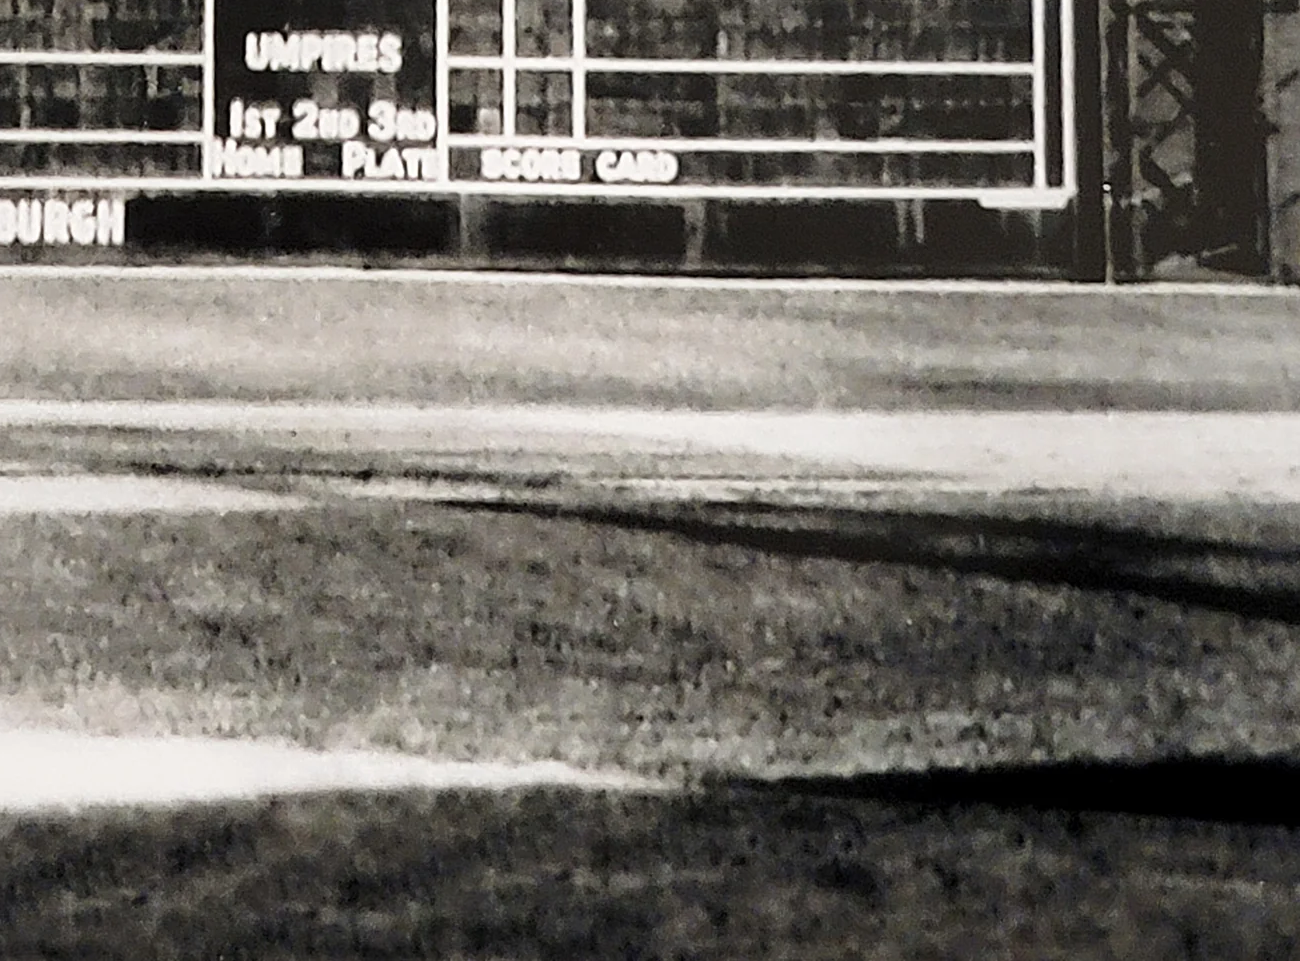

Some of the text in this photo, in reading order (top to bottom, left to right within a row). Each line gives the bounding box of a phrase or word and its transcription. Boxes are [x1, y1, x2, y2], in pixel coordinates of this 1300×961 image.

[245, 30, 403, 73] UMPIRES
[292, 98, 361, 139] 2ND
[367, 99, 437, 142] 3RD
[212, 137, 439, 181] HOME PLATE
[480, 148, 680, 183] SCORE CARD
